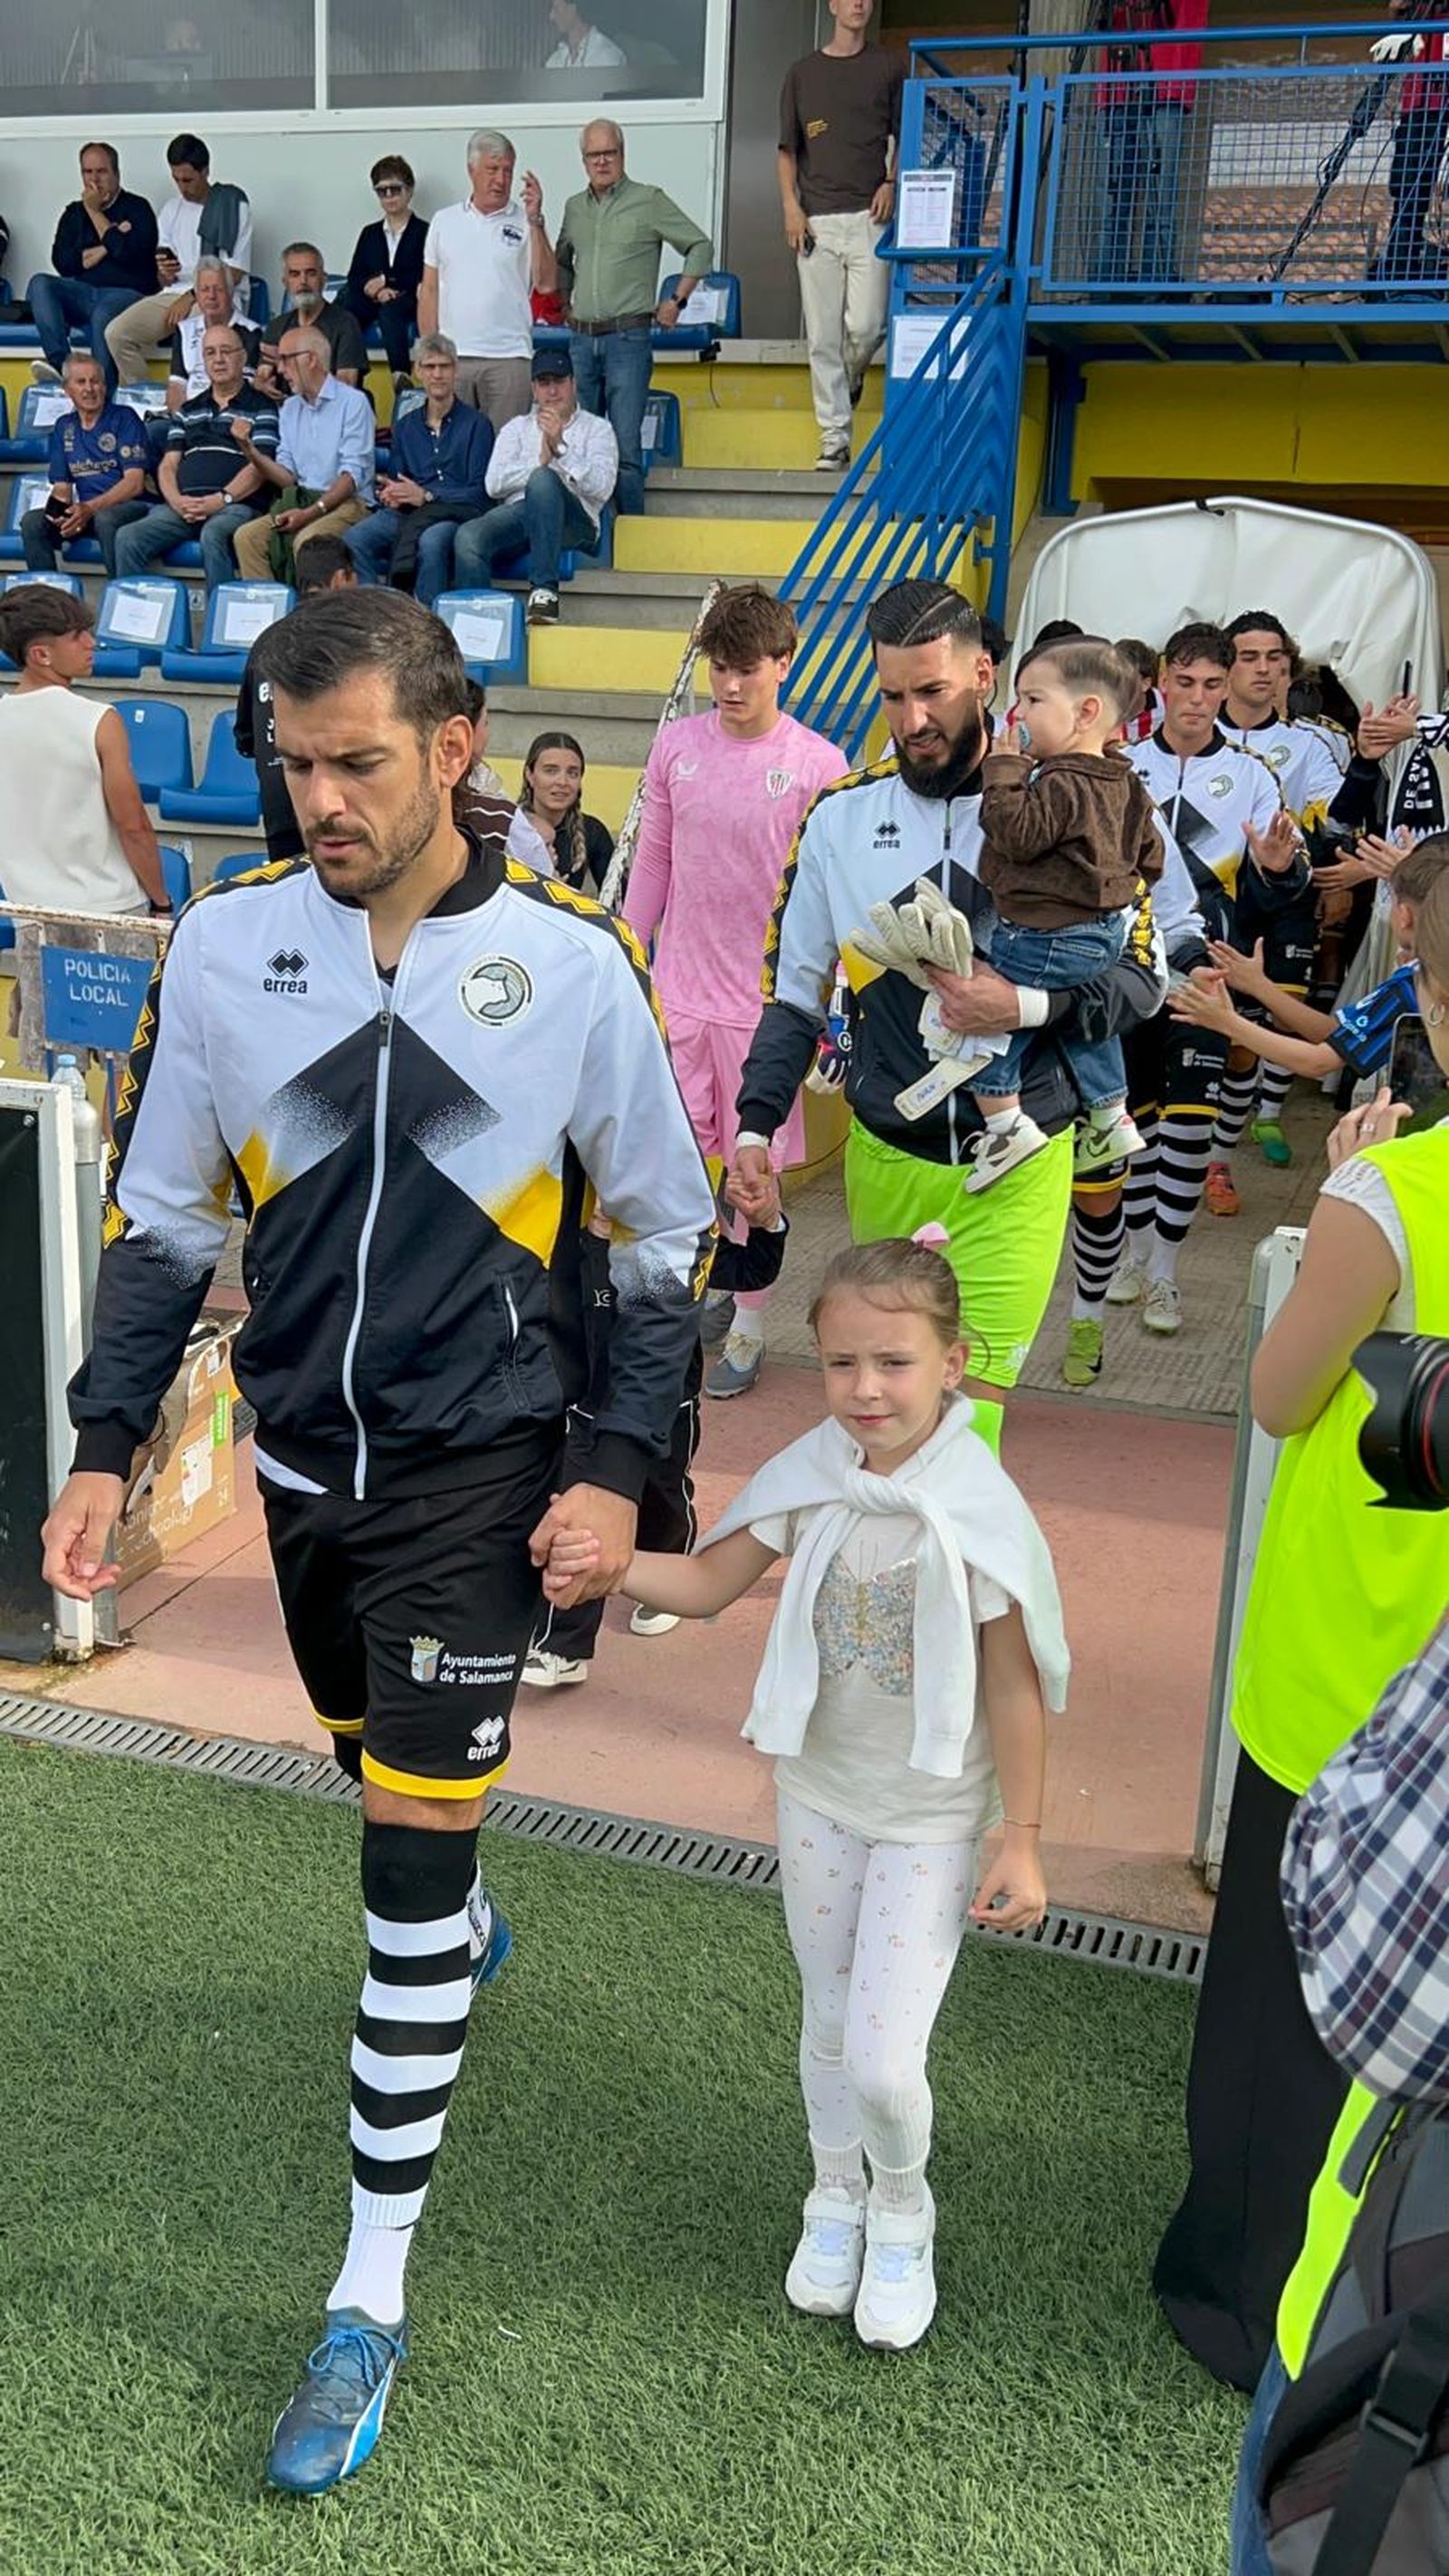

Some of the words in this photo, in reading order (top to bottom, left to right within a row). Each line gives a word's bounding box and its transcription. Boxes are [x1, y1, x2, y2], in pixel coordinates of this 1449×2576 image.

[64, 958, 131, 985] POLICIA
[70, 983, 130, 1007] LOCAL
[263, 978, 308, 994] errea
[441, 1652, 517, 1670] Ayuntamiento
[439, 1668, 456, 1683] de
[459, 1670, 513, 1685] Salamanca
[467, 1740, 502, 1761] errea
